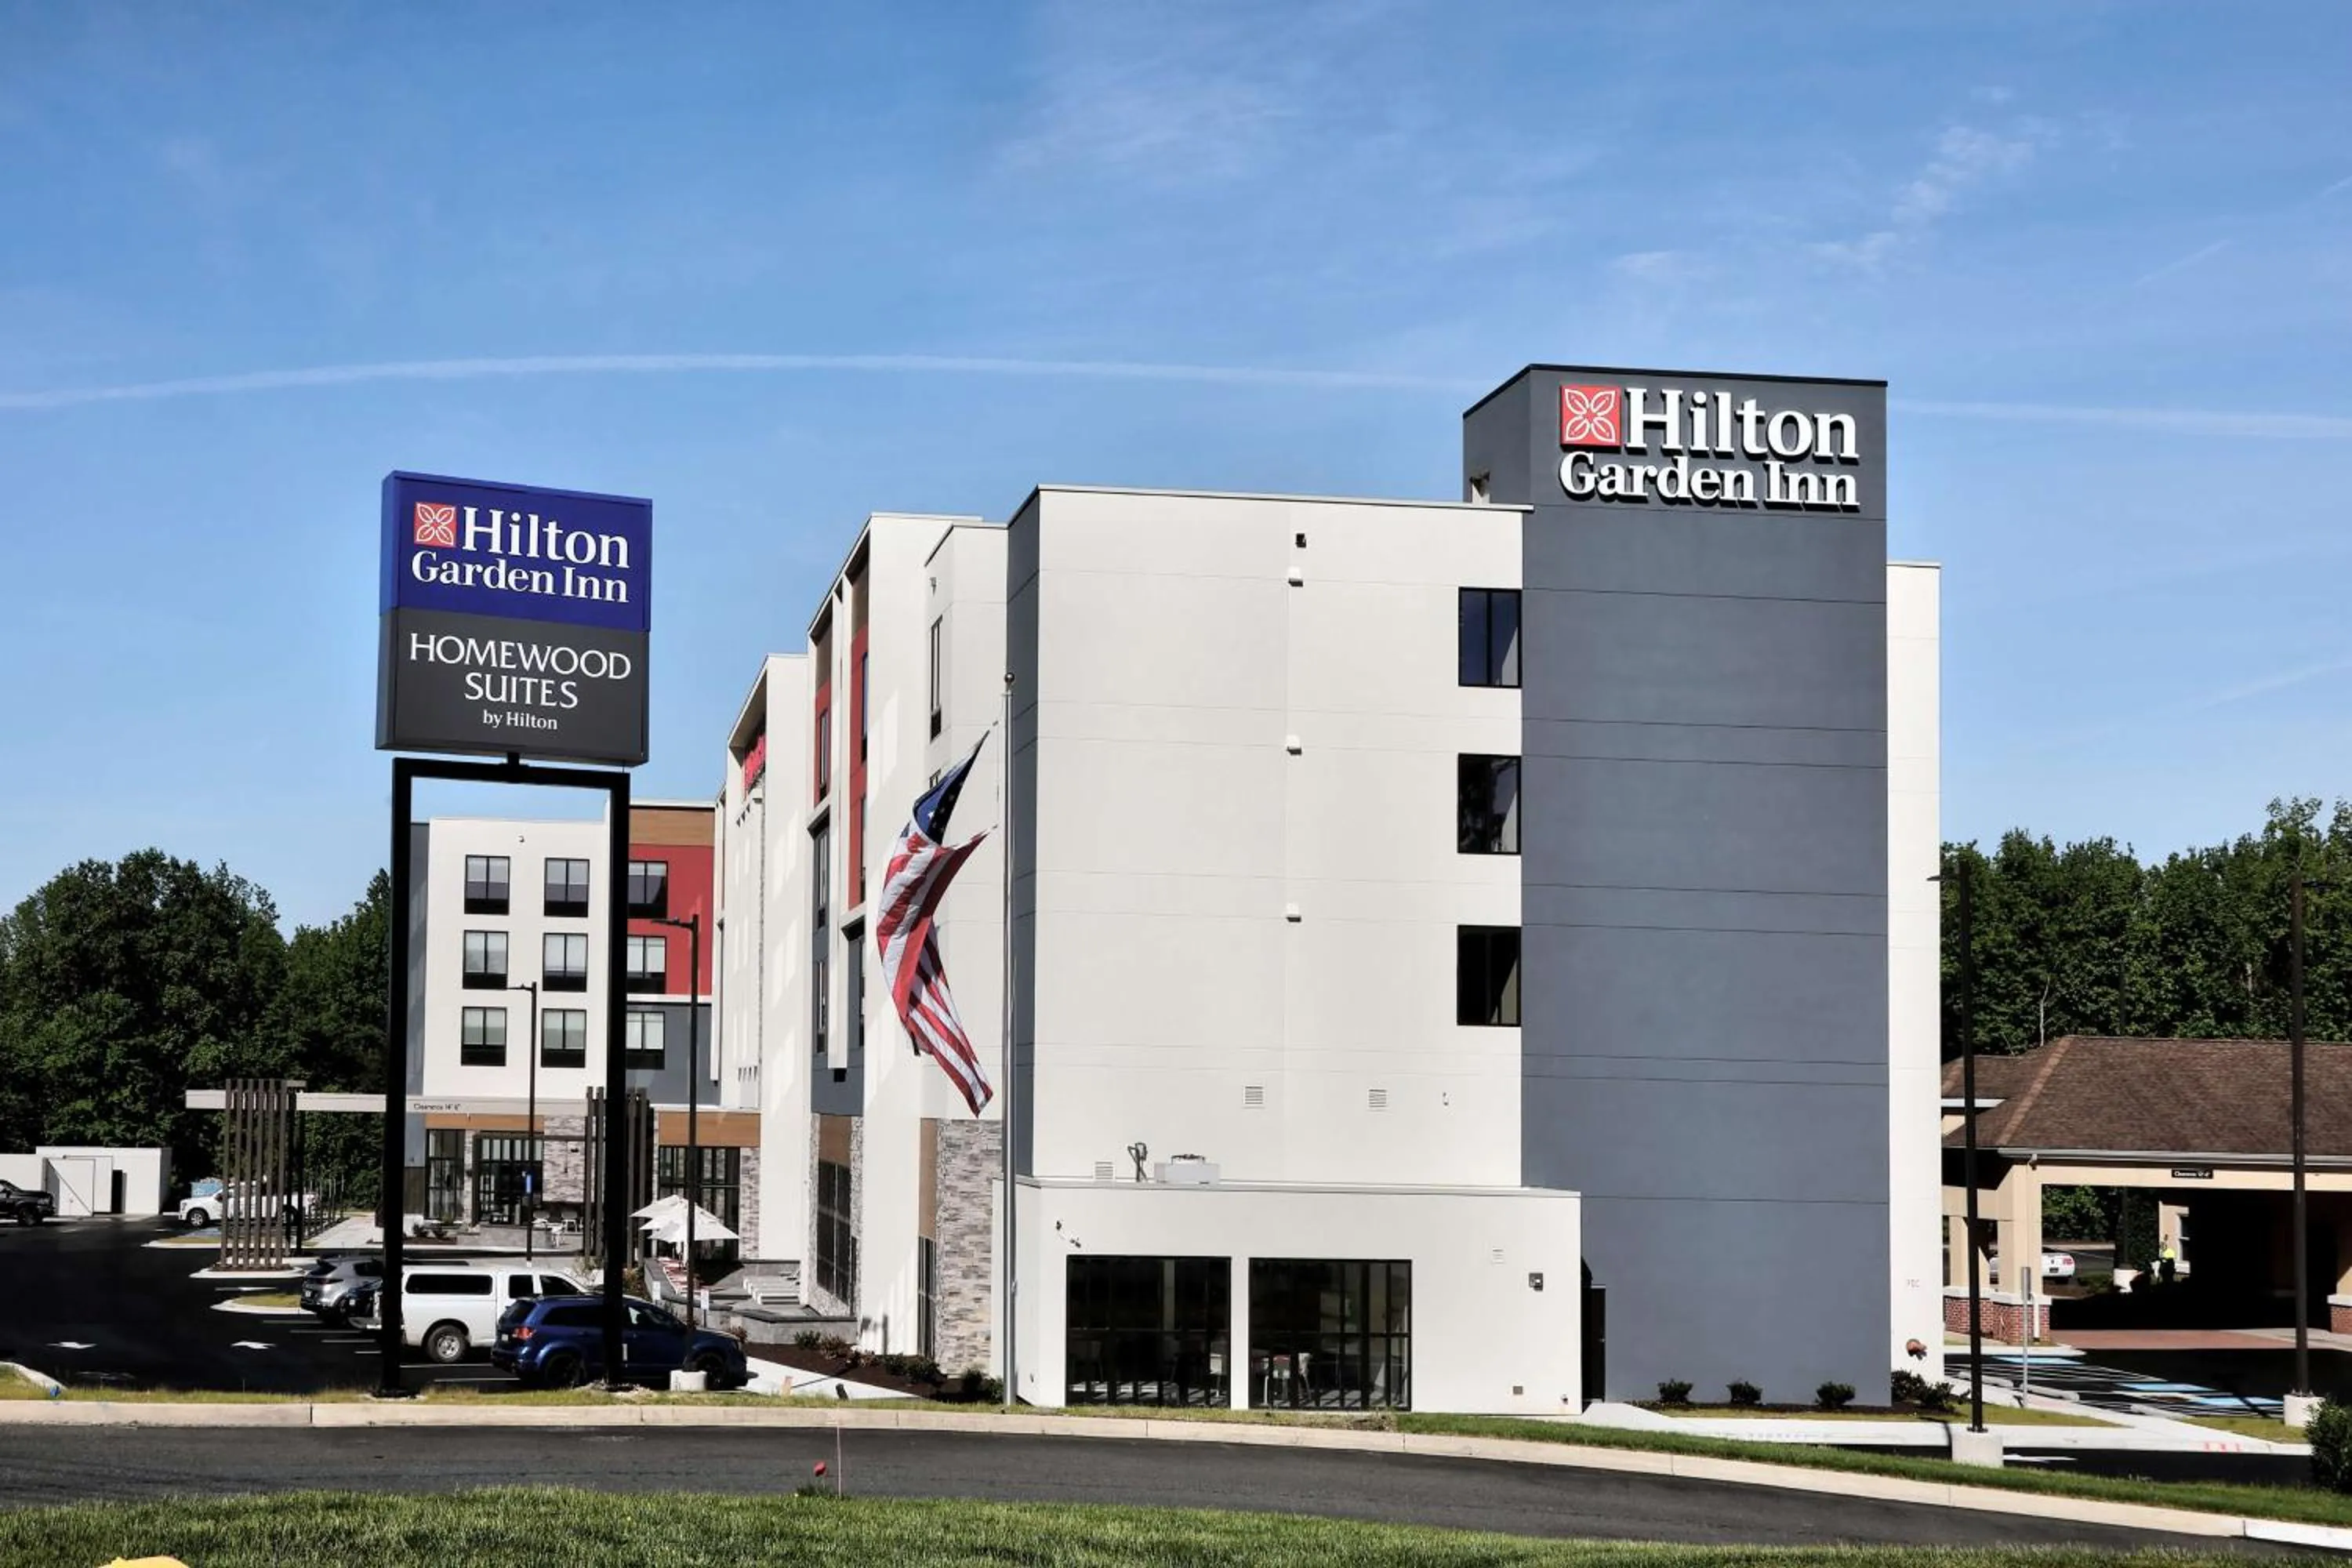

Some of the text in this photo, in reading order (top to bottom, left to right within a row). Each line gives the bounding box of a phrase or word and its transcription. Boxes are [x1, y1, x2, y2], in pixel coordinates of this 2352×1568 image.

[1625, 387, 1860, 461] Hilton
[1559, 451, 1860, 506] Garden Inn
[463, 506, 630, 569] Hilton
[412, 550, 630, 603] Garden Inn
[410, 633, 631, 681] HOMEWOOD
[464, 672, 579, 708] SUITES
[483, 710, 558, 730] by Hilton
